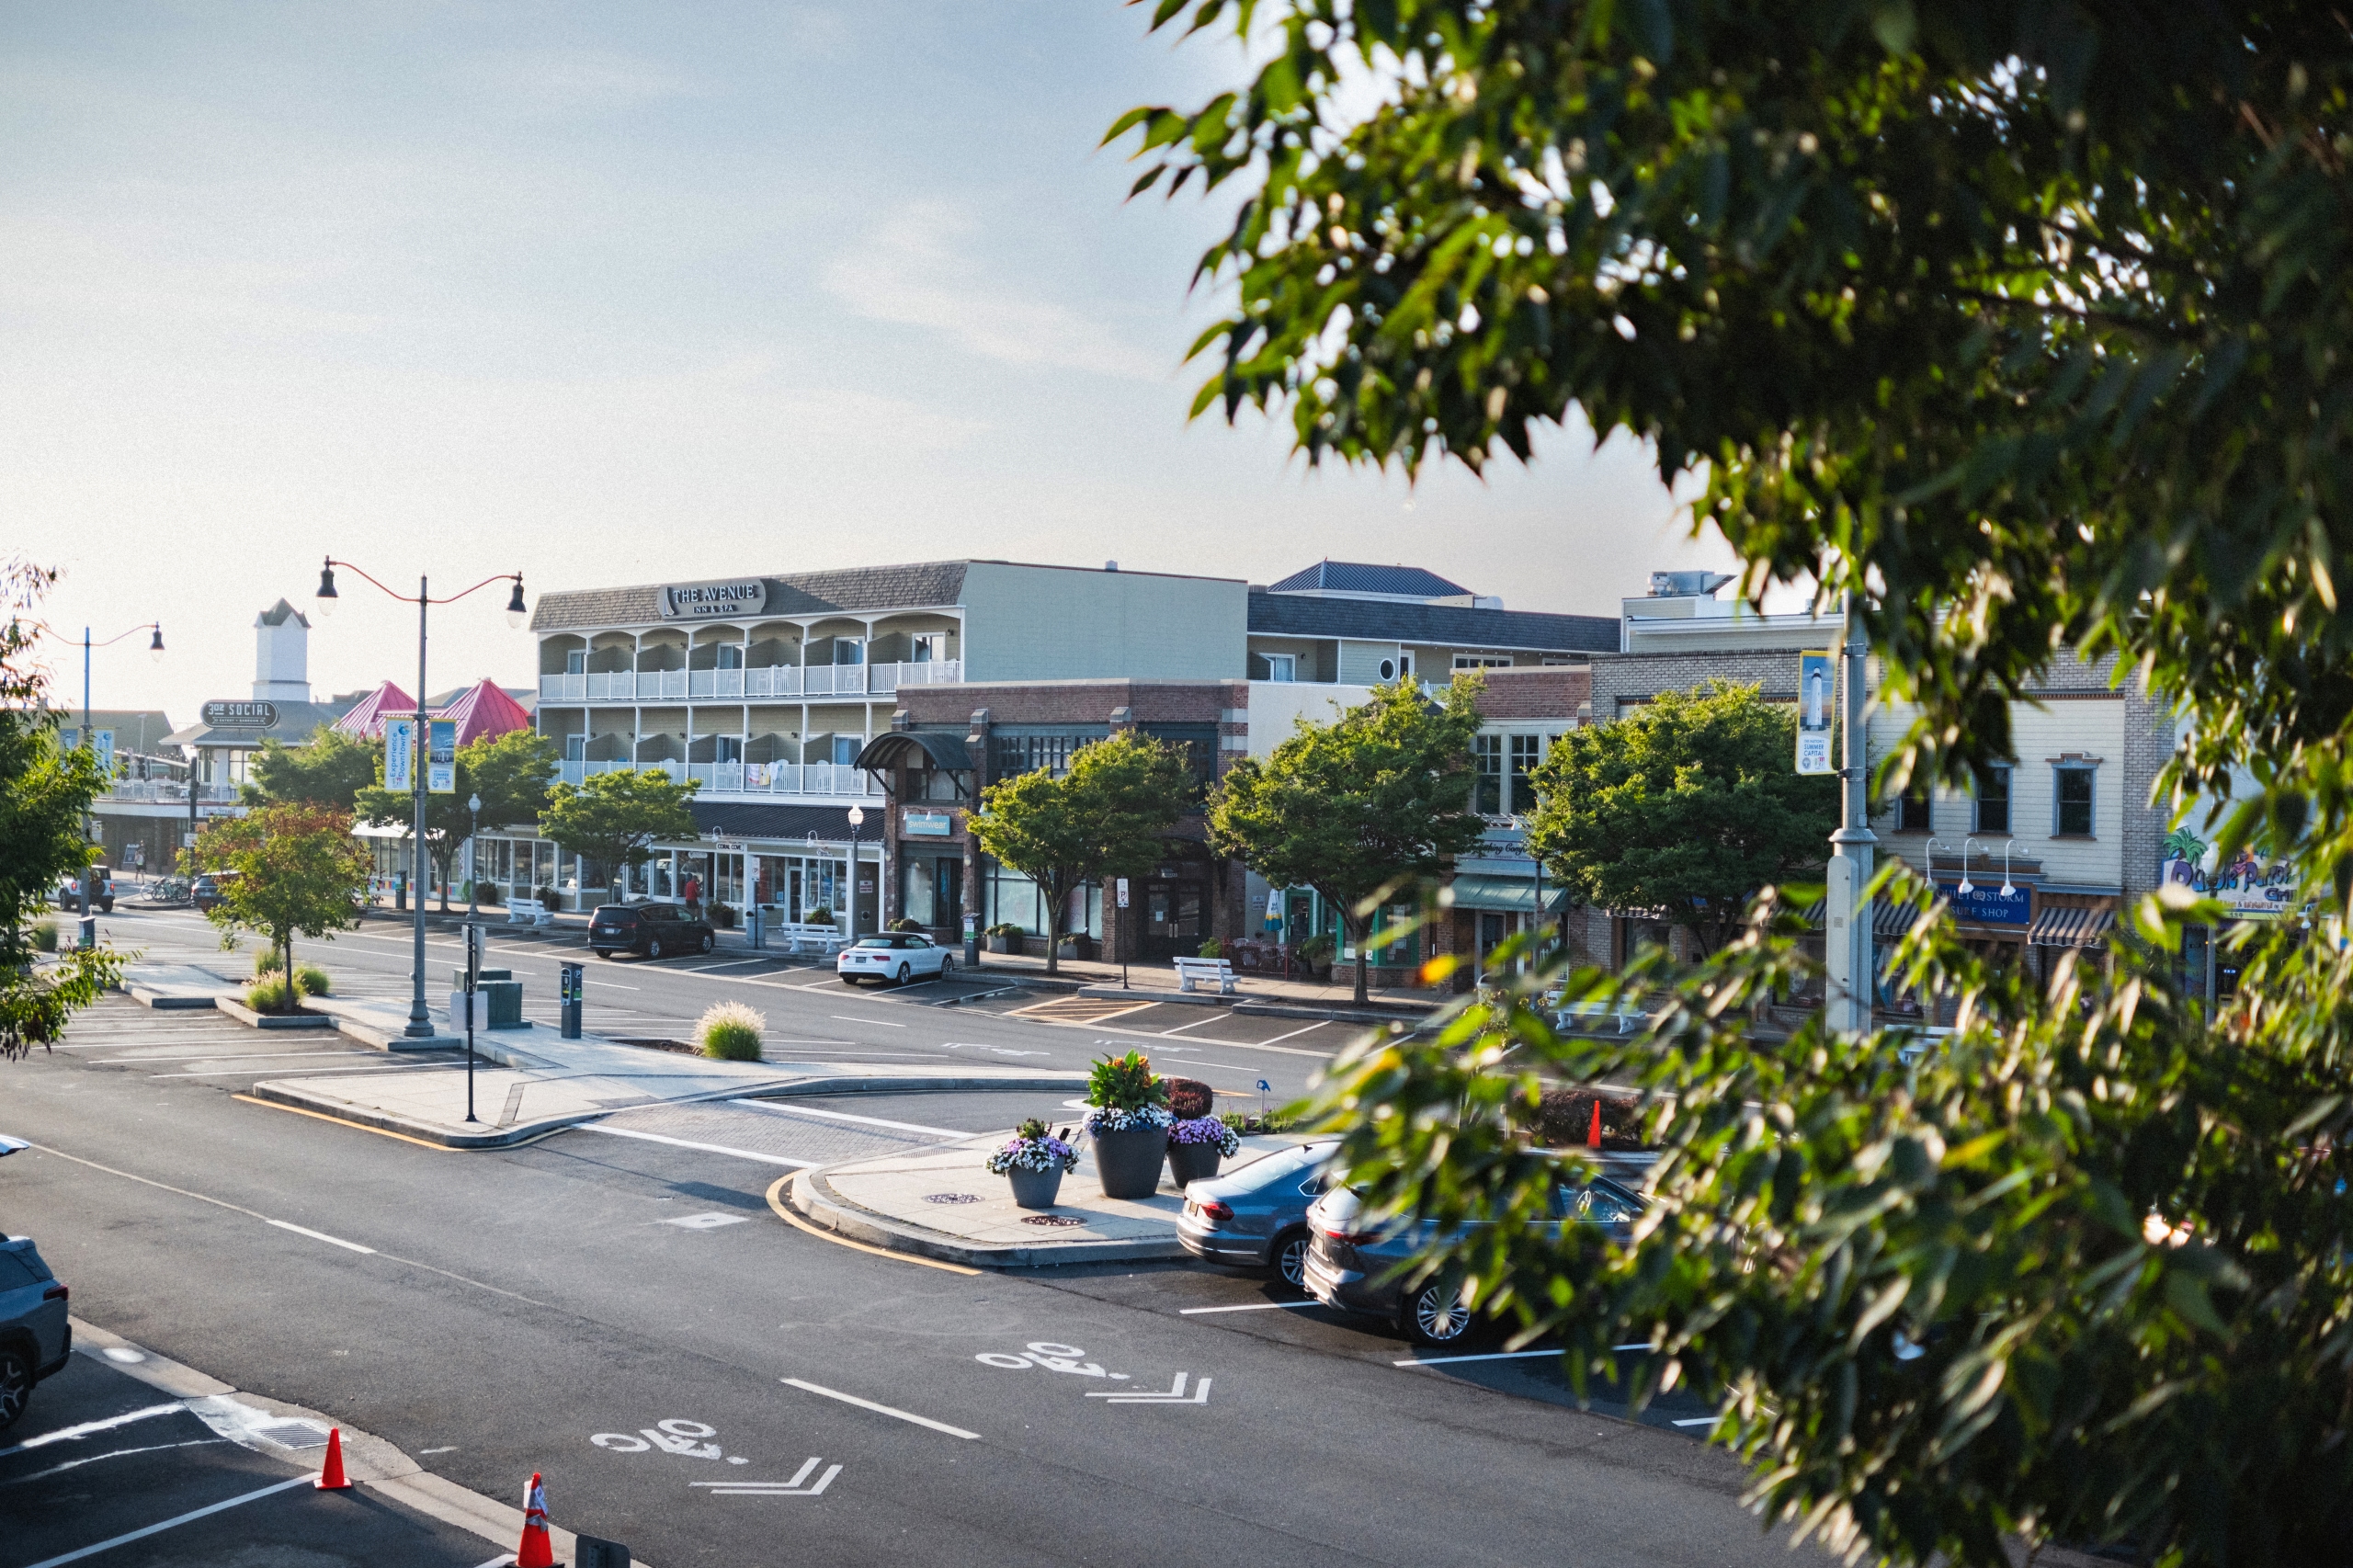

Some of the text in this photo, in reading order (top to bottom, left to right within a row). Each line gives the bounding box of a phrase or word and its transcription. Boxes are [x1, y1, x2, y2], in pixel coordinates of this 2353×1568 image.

[674, 585, 754, 603] THE AVENUE
[208, 703, 269, 715] 302 SOCIAL
[390, 733, 398, 778] Experience
[398, 735, 406, 778] Downtown
[908, 820, 947, 829] swimwear
[1986, 892, 2024, 903] STORM
[1951, 906, 2009, 918] SURF SHOP
